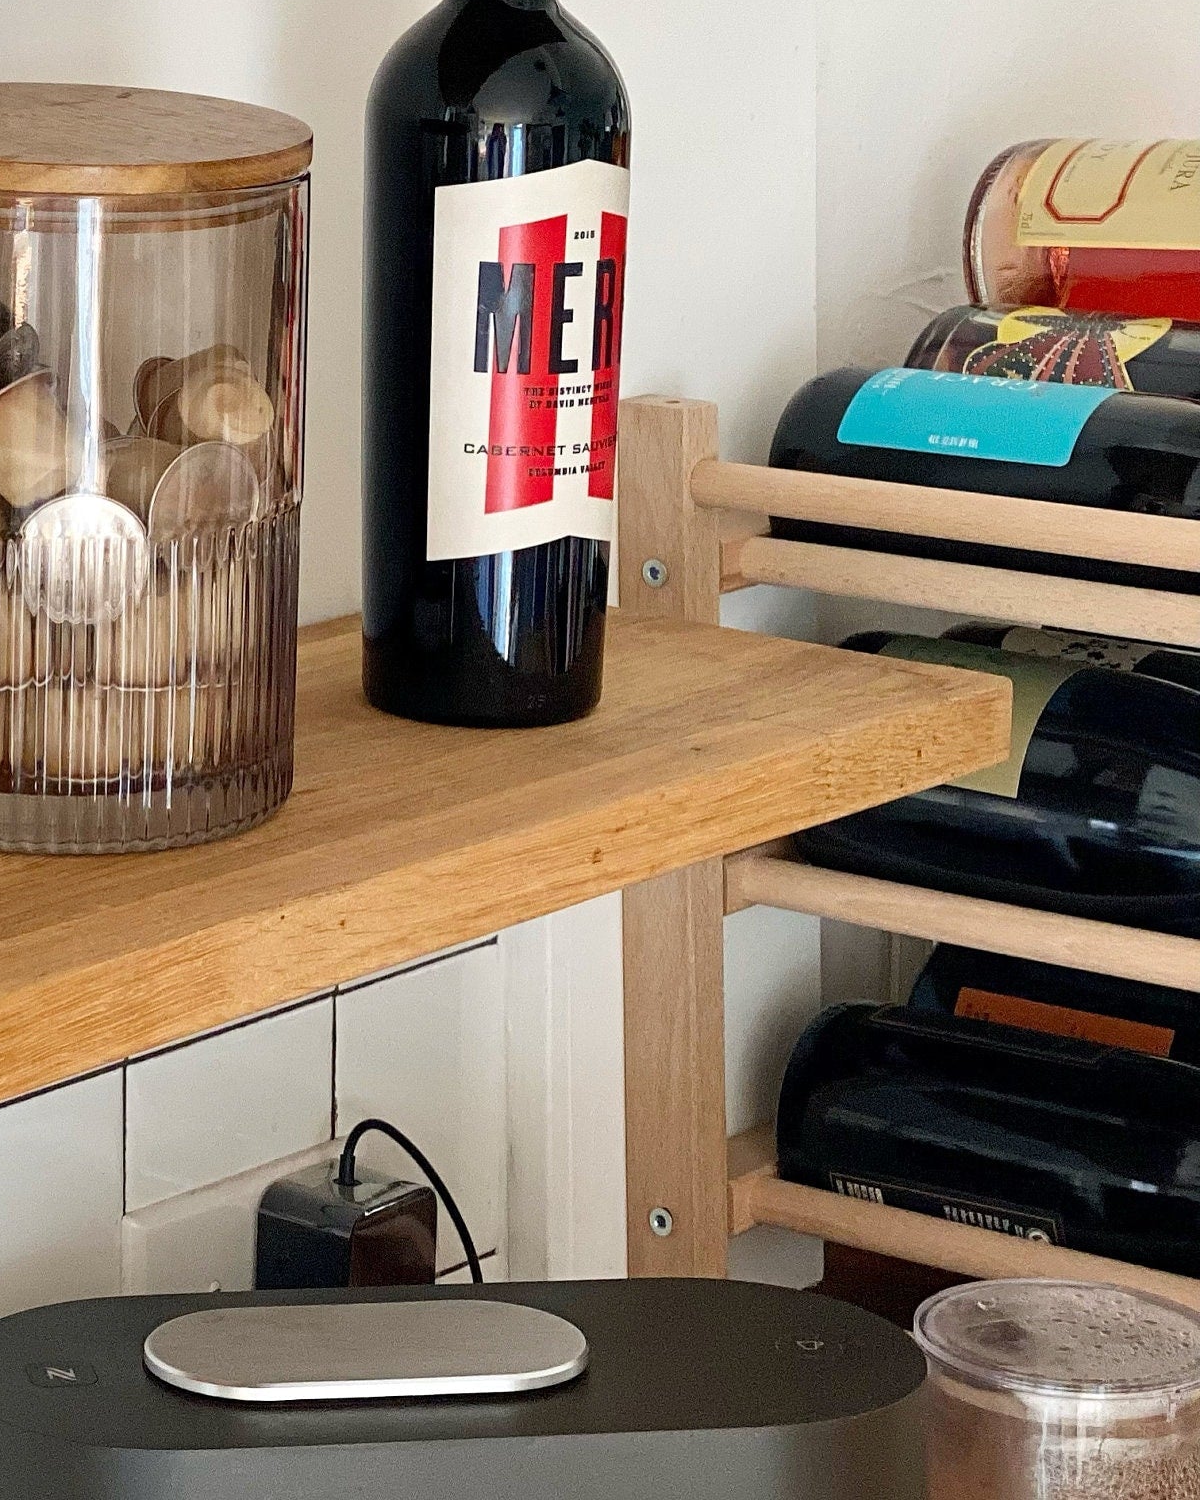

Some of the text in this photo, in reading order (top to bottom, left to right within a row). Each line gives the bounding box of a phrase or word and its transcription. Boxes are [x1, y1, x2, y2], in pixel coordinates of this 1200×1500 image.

[473, 256, 625, 374] MER
[548, 384, 592, 396] DISTINCT
[546, 398, 575, 409] DAVID
[463, 443, 567, 457] CABERNET
[528, 465, 577, 477] COLUMBIA
